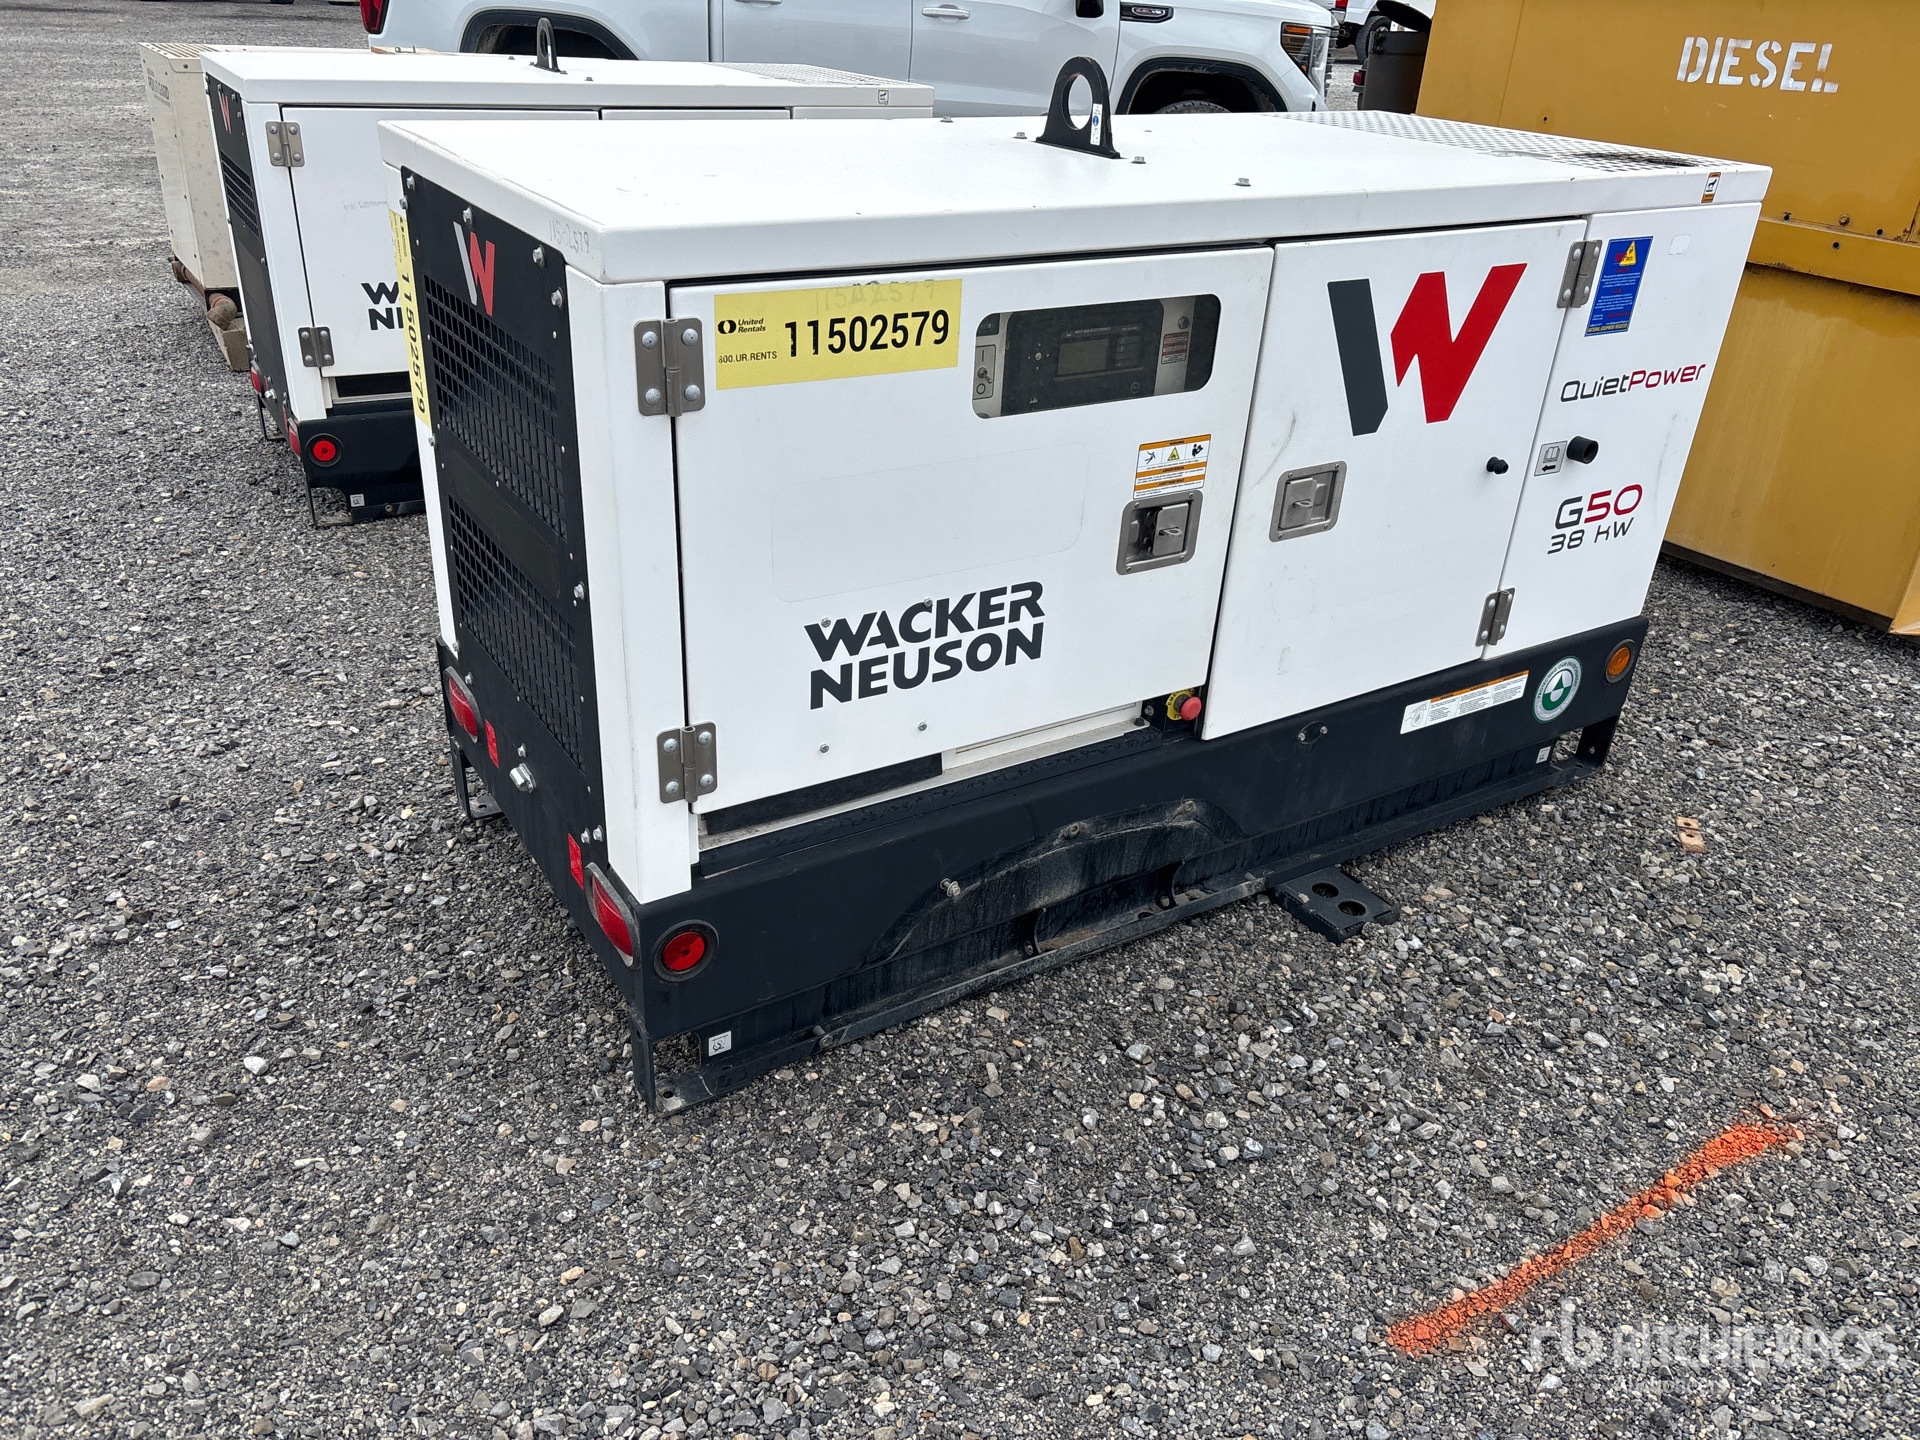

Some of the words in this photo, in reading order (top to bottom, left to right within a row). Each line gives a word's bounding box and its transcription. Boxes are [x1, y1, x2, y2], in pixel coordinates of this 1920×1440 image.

[1676, 36, 1839, 93] DIESEL
[402, 272, 426, 414] 11502579
[737, 317, 764, 326] United
[737, 325, 767, 333] Rentals
[785, 309, 949, 357] 11502579
[719, 350, 778, 364] 800.UR.RENTS
[1561, 363, 1706, 402] QuietPower
[1555, 484, 1643, 530] G50
[1547, 528, 1586, 555] 38
[804, 581, 1045, 662] WACKER
[810, 622, 1044, 710] NEUSON
